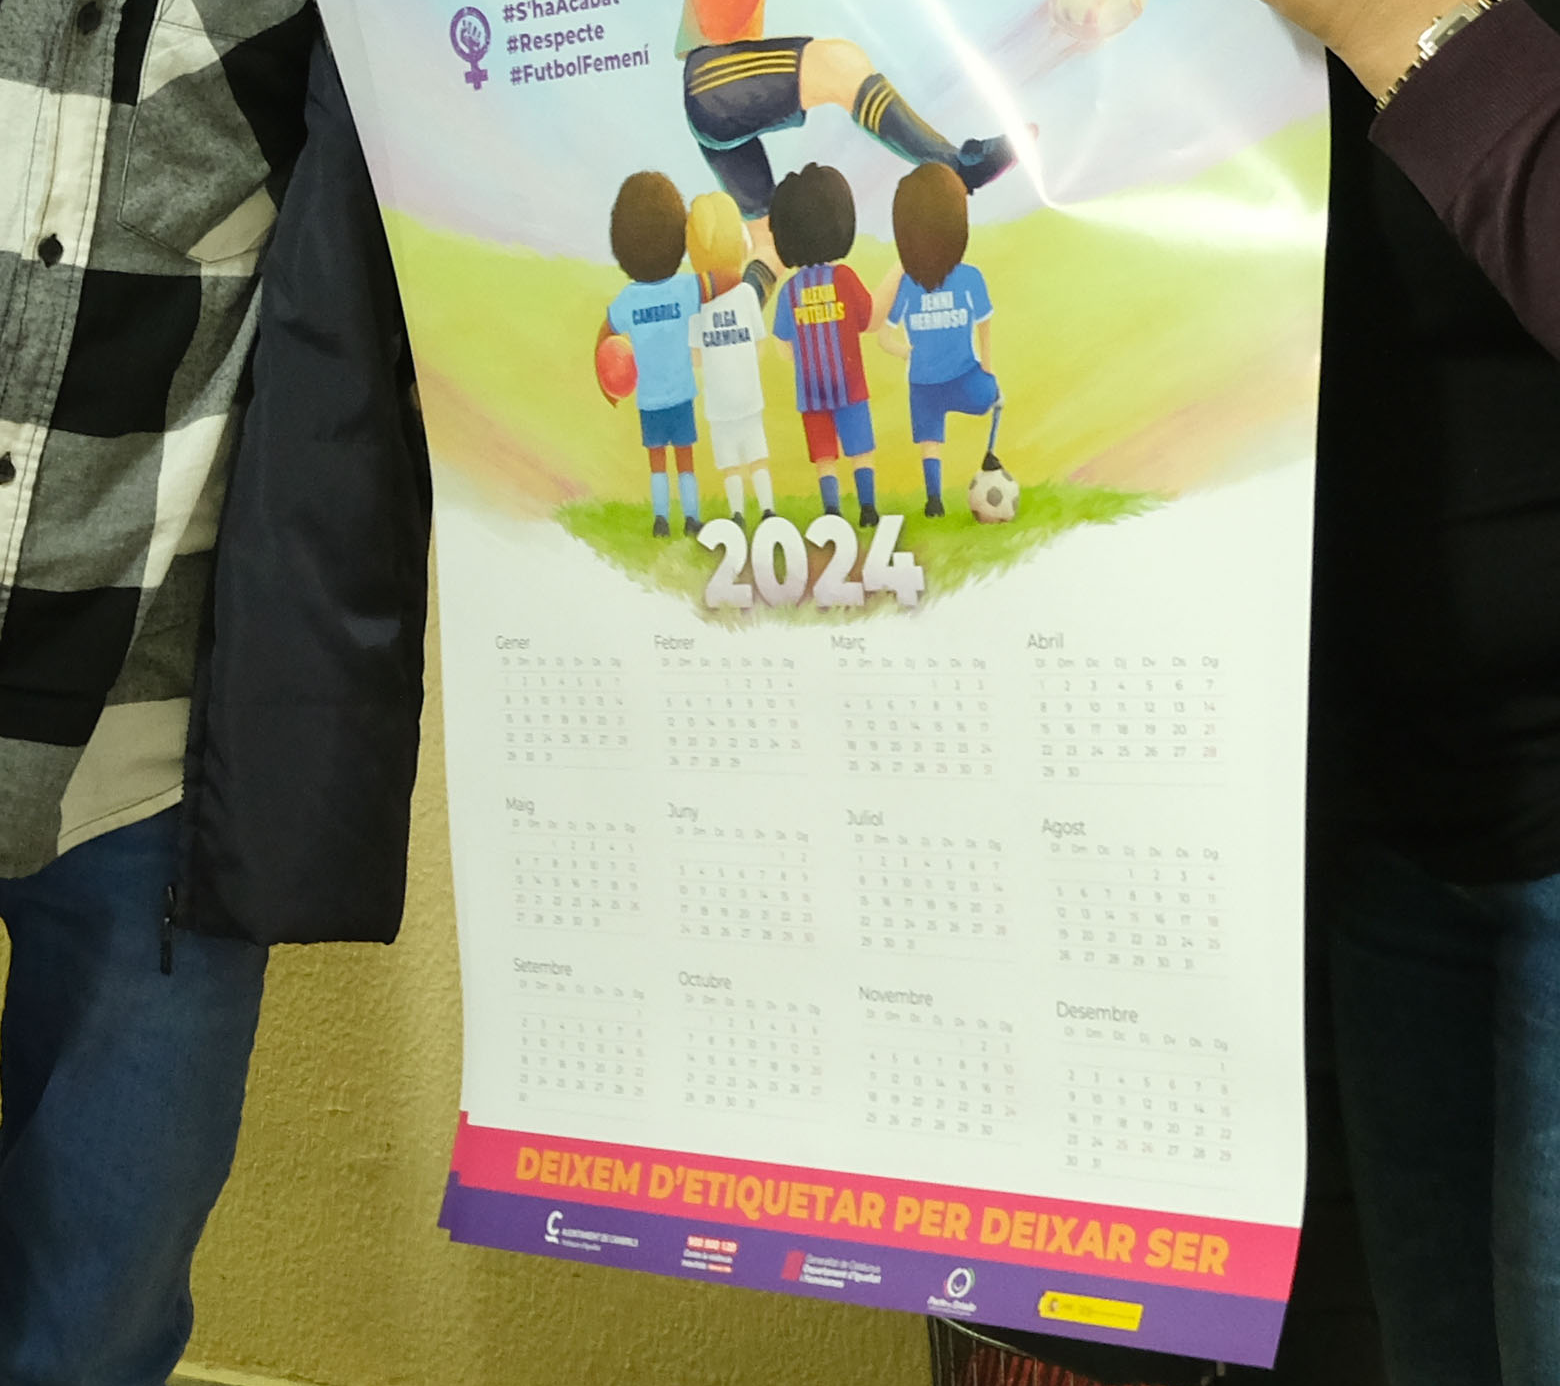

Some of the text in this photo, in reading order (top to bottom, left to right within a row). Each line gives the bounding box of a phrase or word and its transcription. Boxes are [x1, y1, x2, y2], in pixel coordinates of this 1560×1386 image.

[507, 19, 605, 56] #Respecte
[509, 42, 650, 87] #FutbolFemení
[712, 309, 737, 329] OLGA
[702, 326, 751, 347] CARMONA
[696, 513, 925, 611] 2024
[495, 635, 530, 650] Gener
[654, 635, 695, 650] Febrer
[831, 635, 866, 654] Març
[1026, 633, 1064, 650] Abril
[505, 797, 535, 816] Maig
[846, 809, 883, 827] Juliol
[1041, 818, 1086, 838] Agost
[513, 957, 573, 977] Setembre
[678, 971, 732, 990] Octubre
[859, 986, 933, 1007] Novembre
[1056, 1000, 1139, 1024] Desembre
[516, 1146, 1230, 1276] DEIXEM D'ETIQUETAR PER DEIXAR SER
